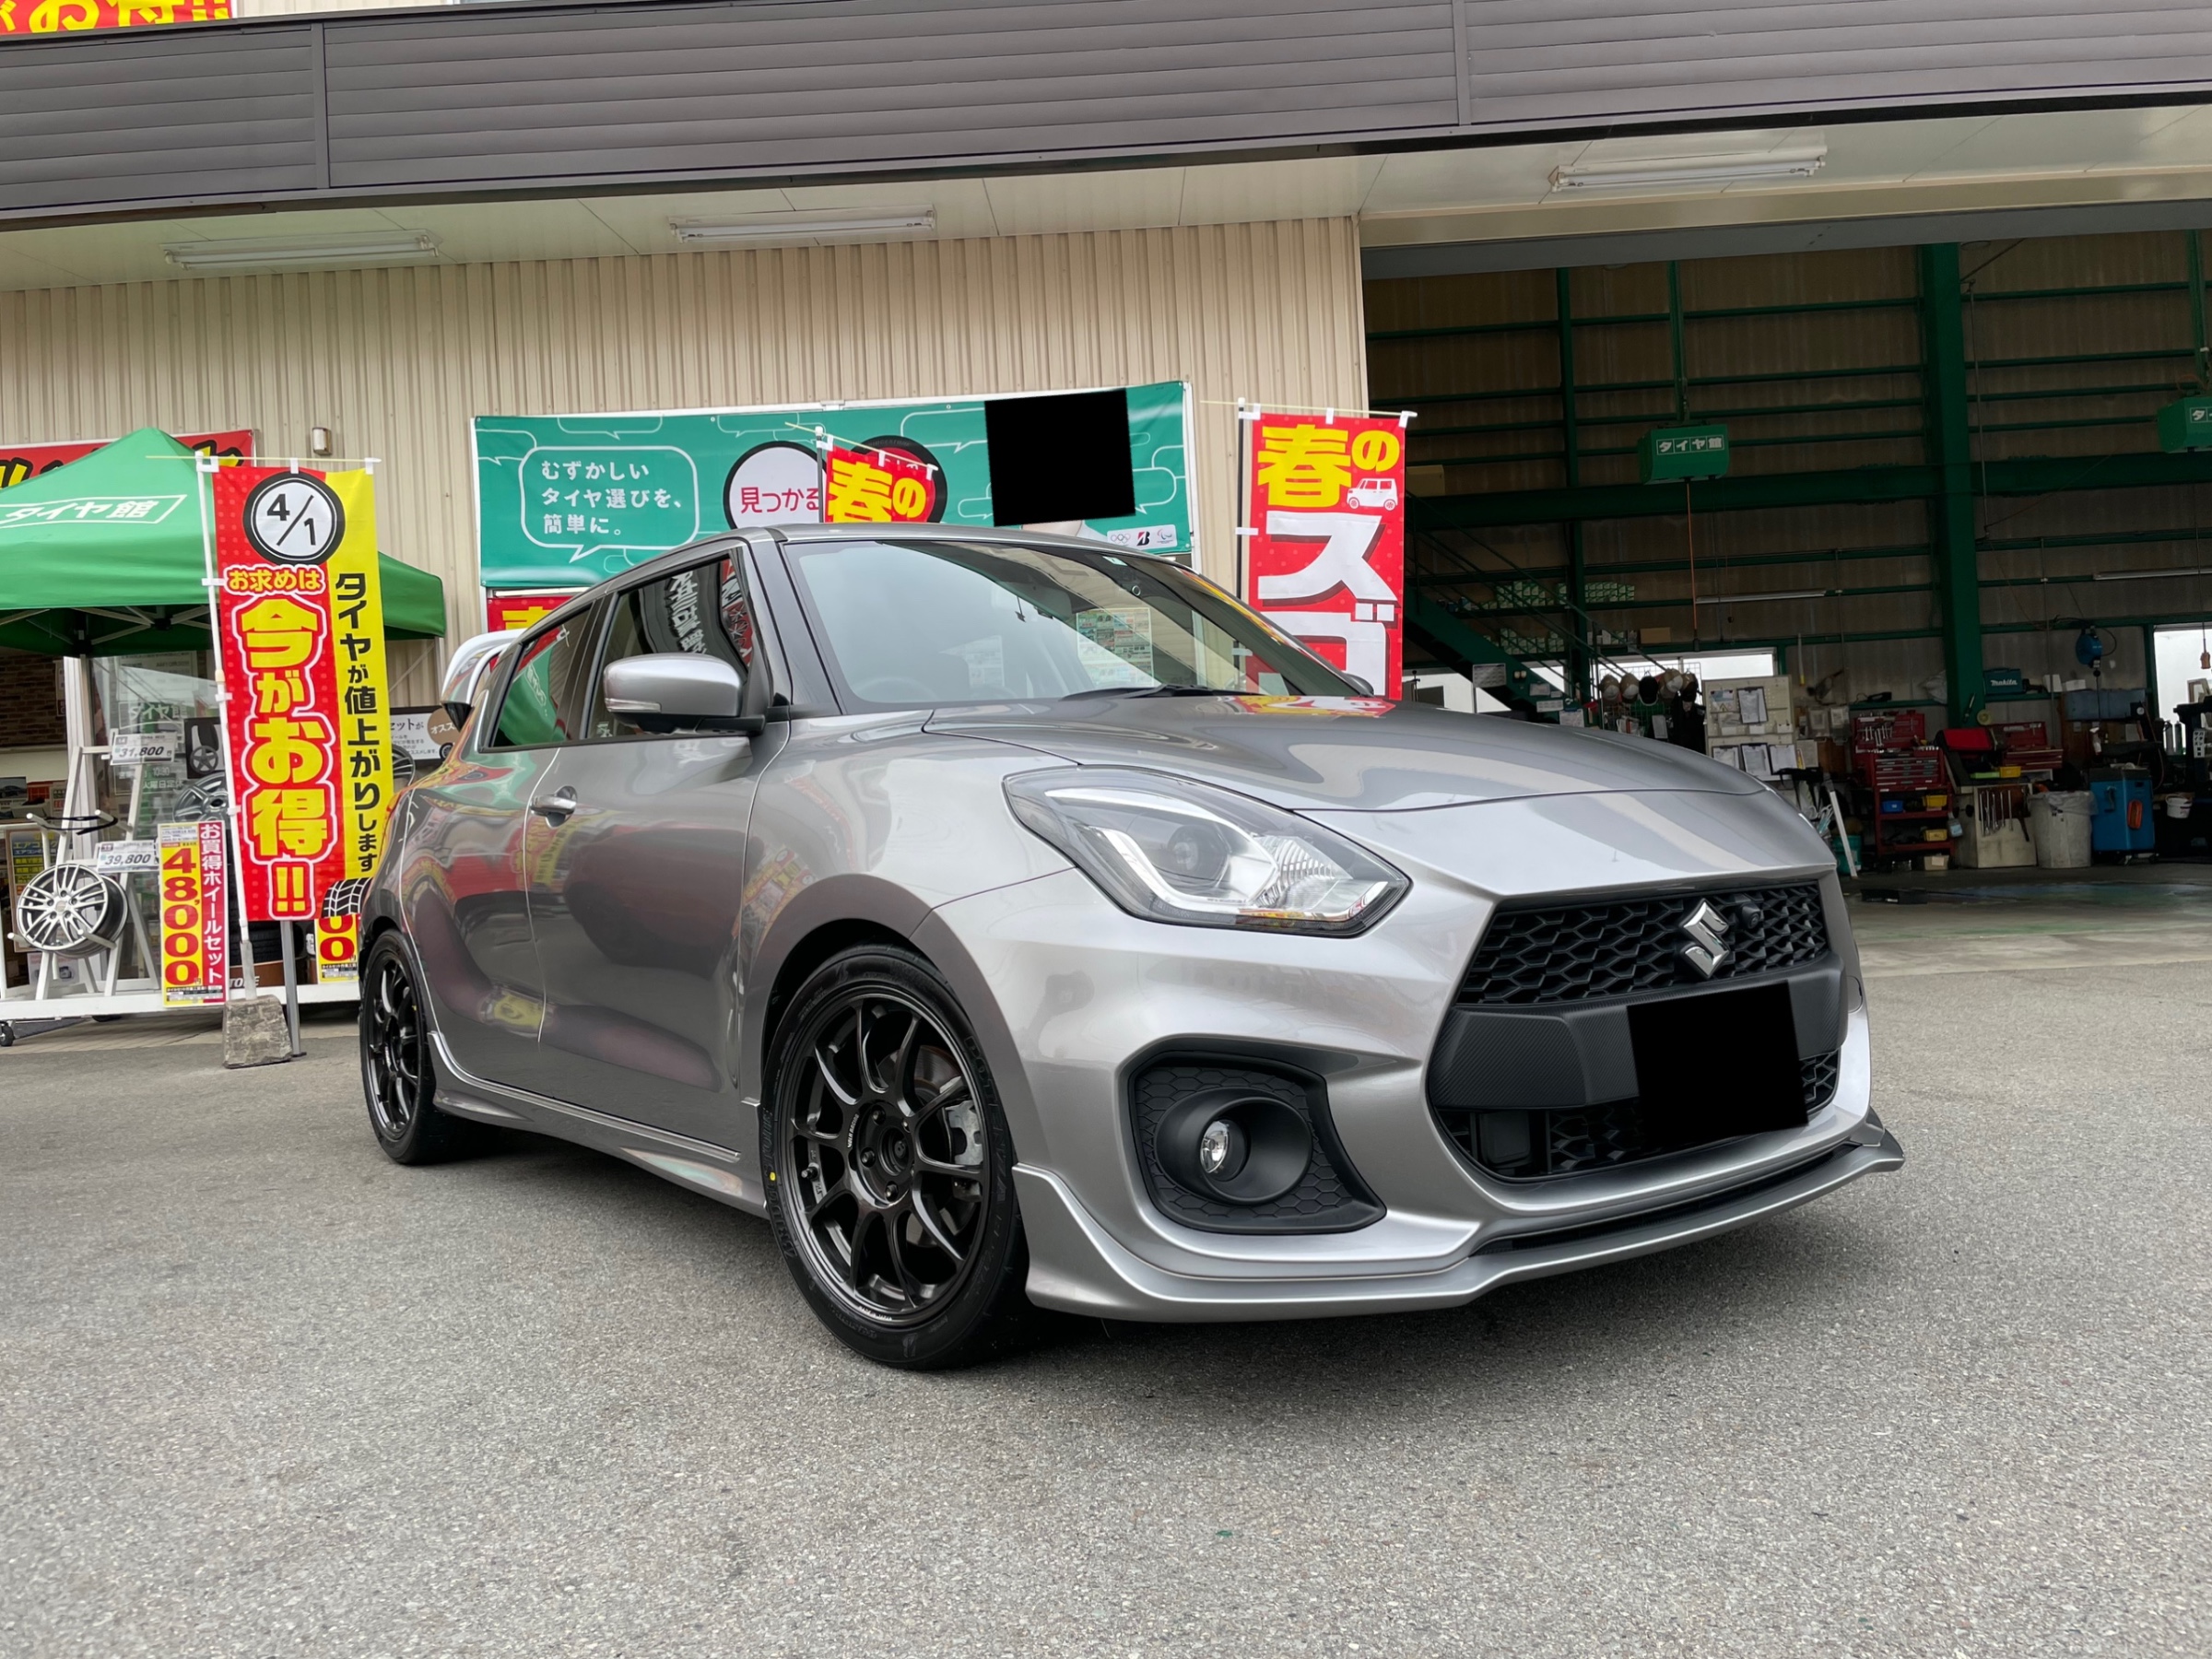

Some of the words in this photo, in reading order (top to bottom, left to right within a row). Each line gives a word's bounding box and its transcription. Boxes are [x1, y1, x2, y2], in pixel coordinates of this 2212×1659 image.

[1659, 438, 1723, 453] タイヤ館
[541, 461, 649, 480] むずかしい
[1257, 423, 1400, 508] 春の
[541, 488, 681, 508] タイヤ選びを、
[741, 487, 819, 513] 見つかる
[6, 500, 159, 520] タイヤ館
[266, 494, 316, 546] 4/1
[543, 513, 621, 535] 簡単に。
[229, 570, 322, 592] お求めは
[335, 573, 381, 872] タイヤが値上がりします
[430, 723, 456, 734] オスス
[119, 747, 164, 758] 31,800
[105, 853, 151, 865] 39,800
[200, 824, 222, 983] お買得ホイールセット
